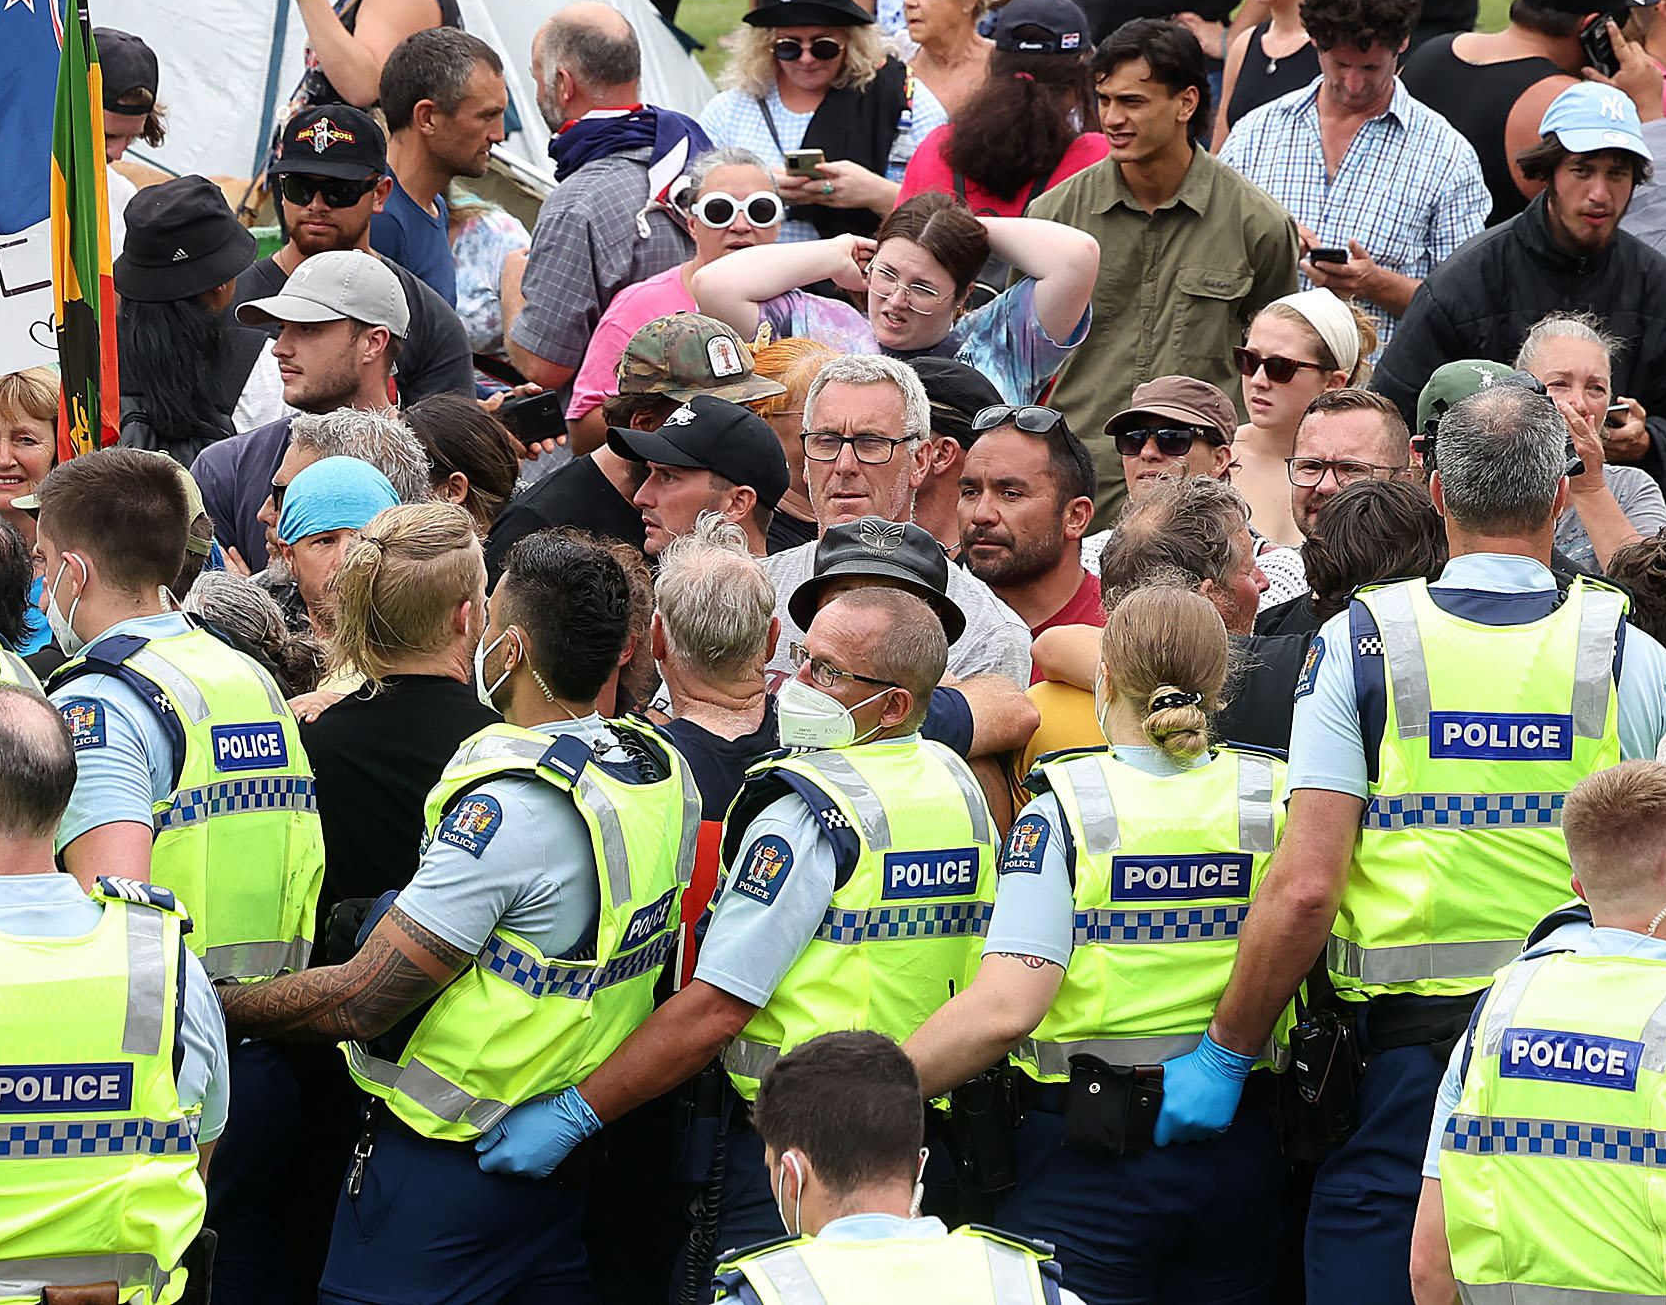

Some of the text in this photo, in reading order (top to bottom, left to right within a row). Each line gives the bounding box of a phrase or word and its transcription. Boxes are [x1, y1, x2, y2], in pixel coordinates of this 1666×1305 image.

[73, 735, 100, 747] LICE
[217, 733, 282, 760] POLICE
[1442, 722, 1561, 749] POLICE
[442, 831, 478, 852] POLICE
[890, 859, 972, 888] POLICE
[1004, 860, 1036, 870] POLICE
[1123, 865, 1240, 890] POLICE
[737, 880, 770, 900] POLICE
[627, 895, 671, 942] POLICE
[1510, 1039, 1629, 1076] POLICE
